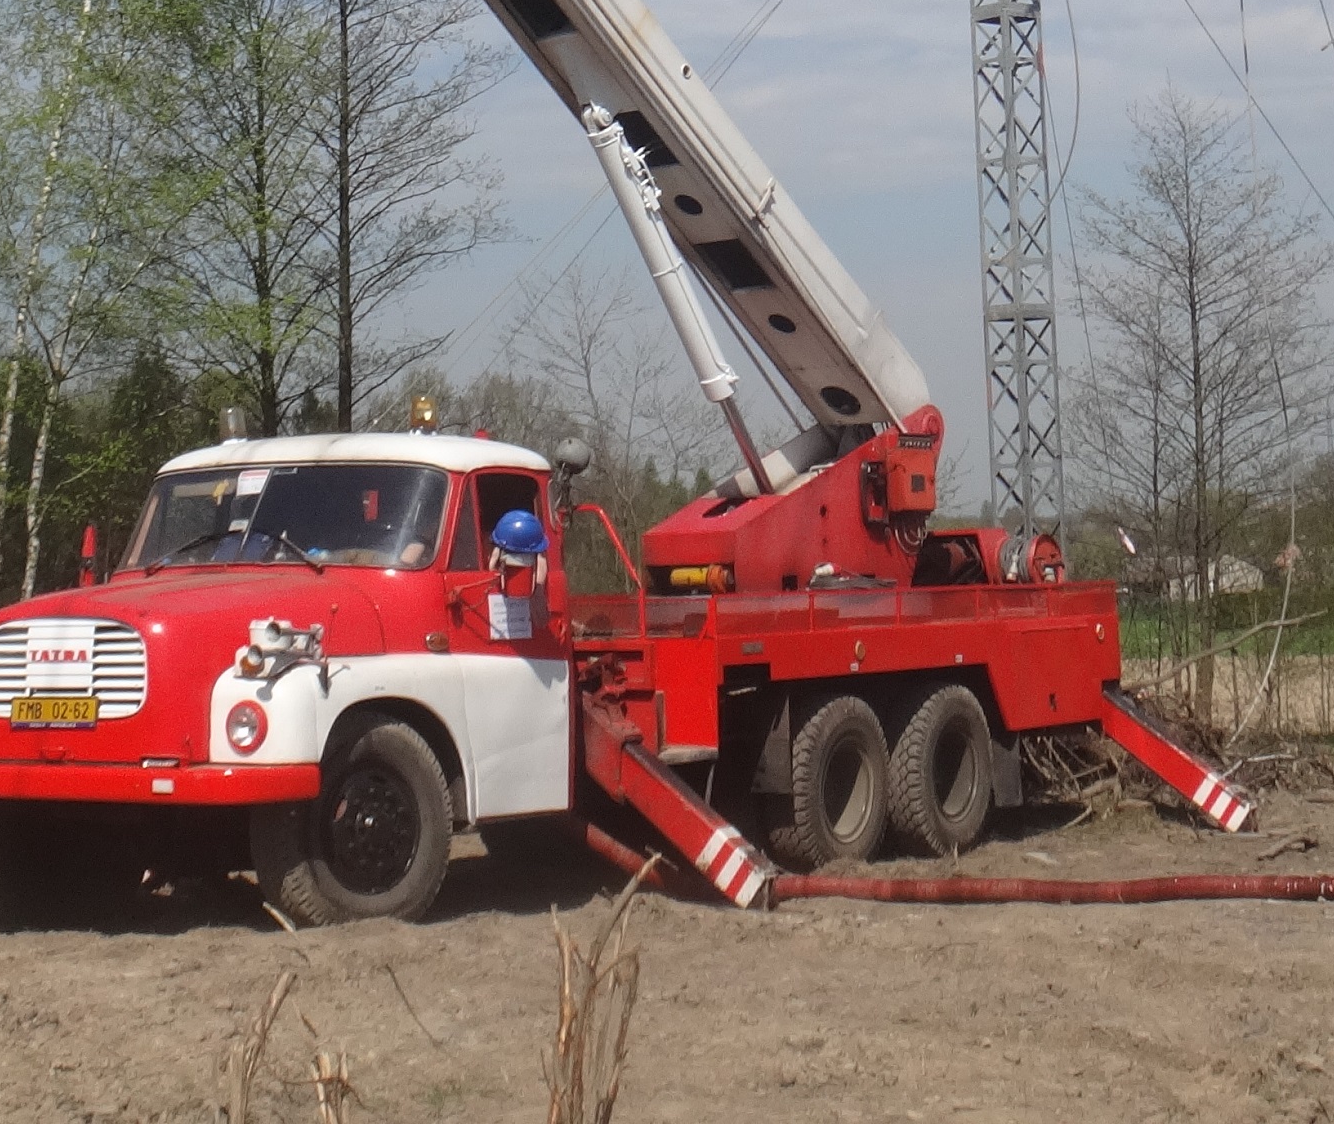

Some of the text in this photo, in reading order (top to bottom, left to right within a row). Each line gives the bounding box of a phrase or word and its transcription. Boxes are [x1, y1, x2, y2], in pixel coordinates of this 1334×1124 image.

[29, 650, 87, 662] TATRA
[17, 702, 89, 720] FMB 02-62
